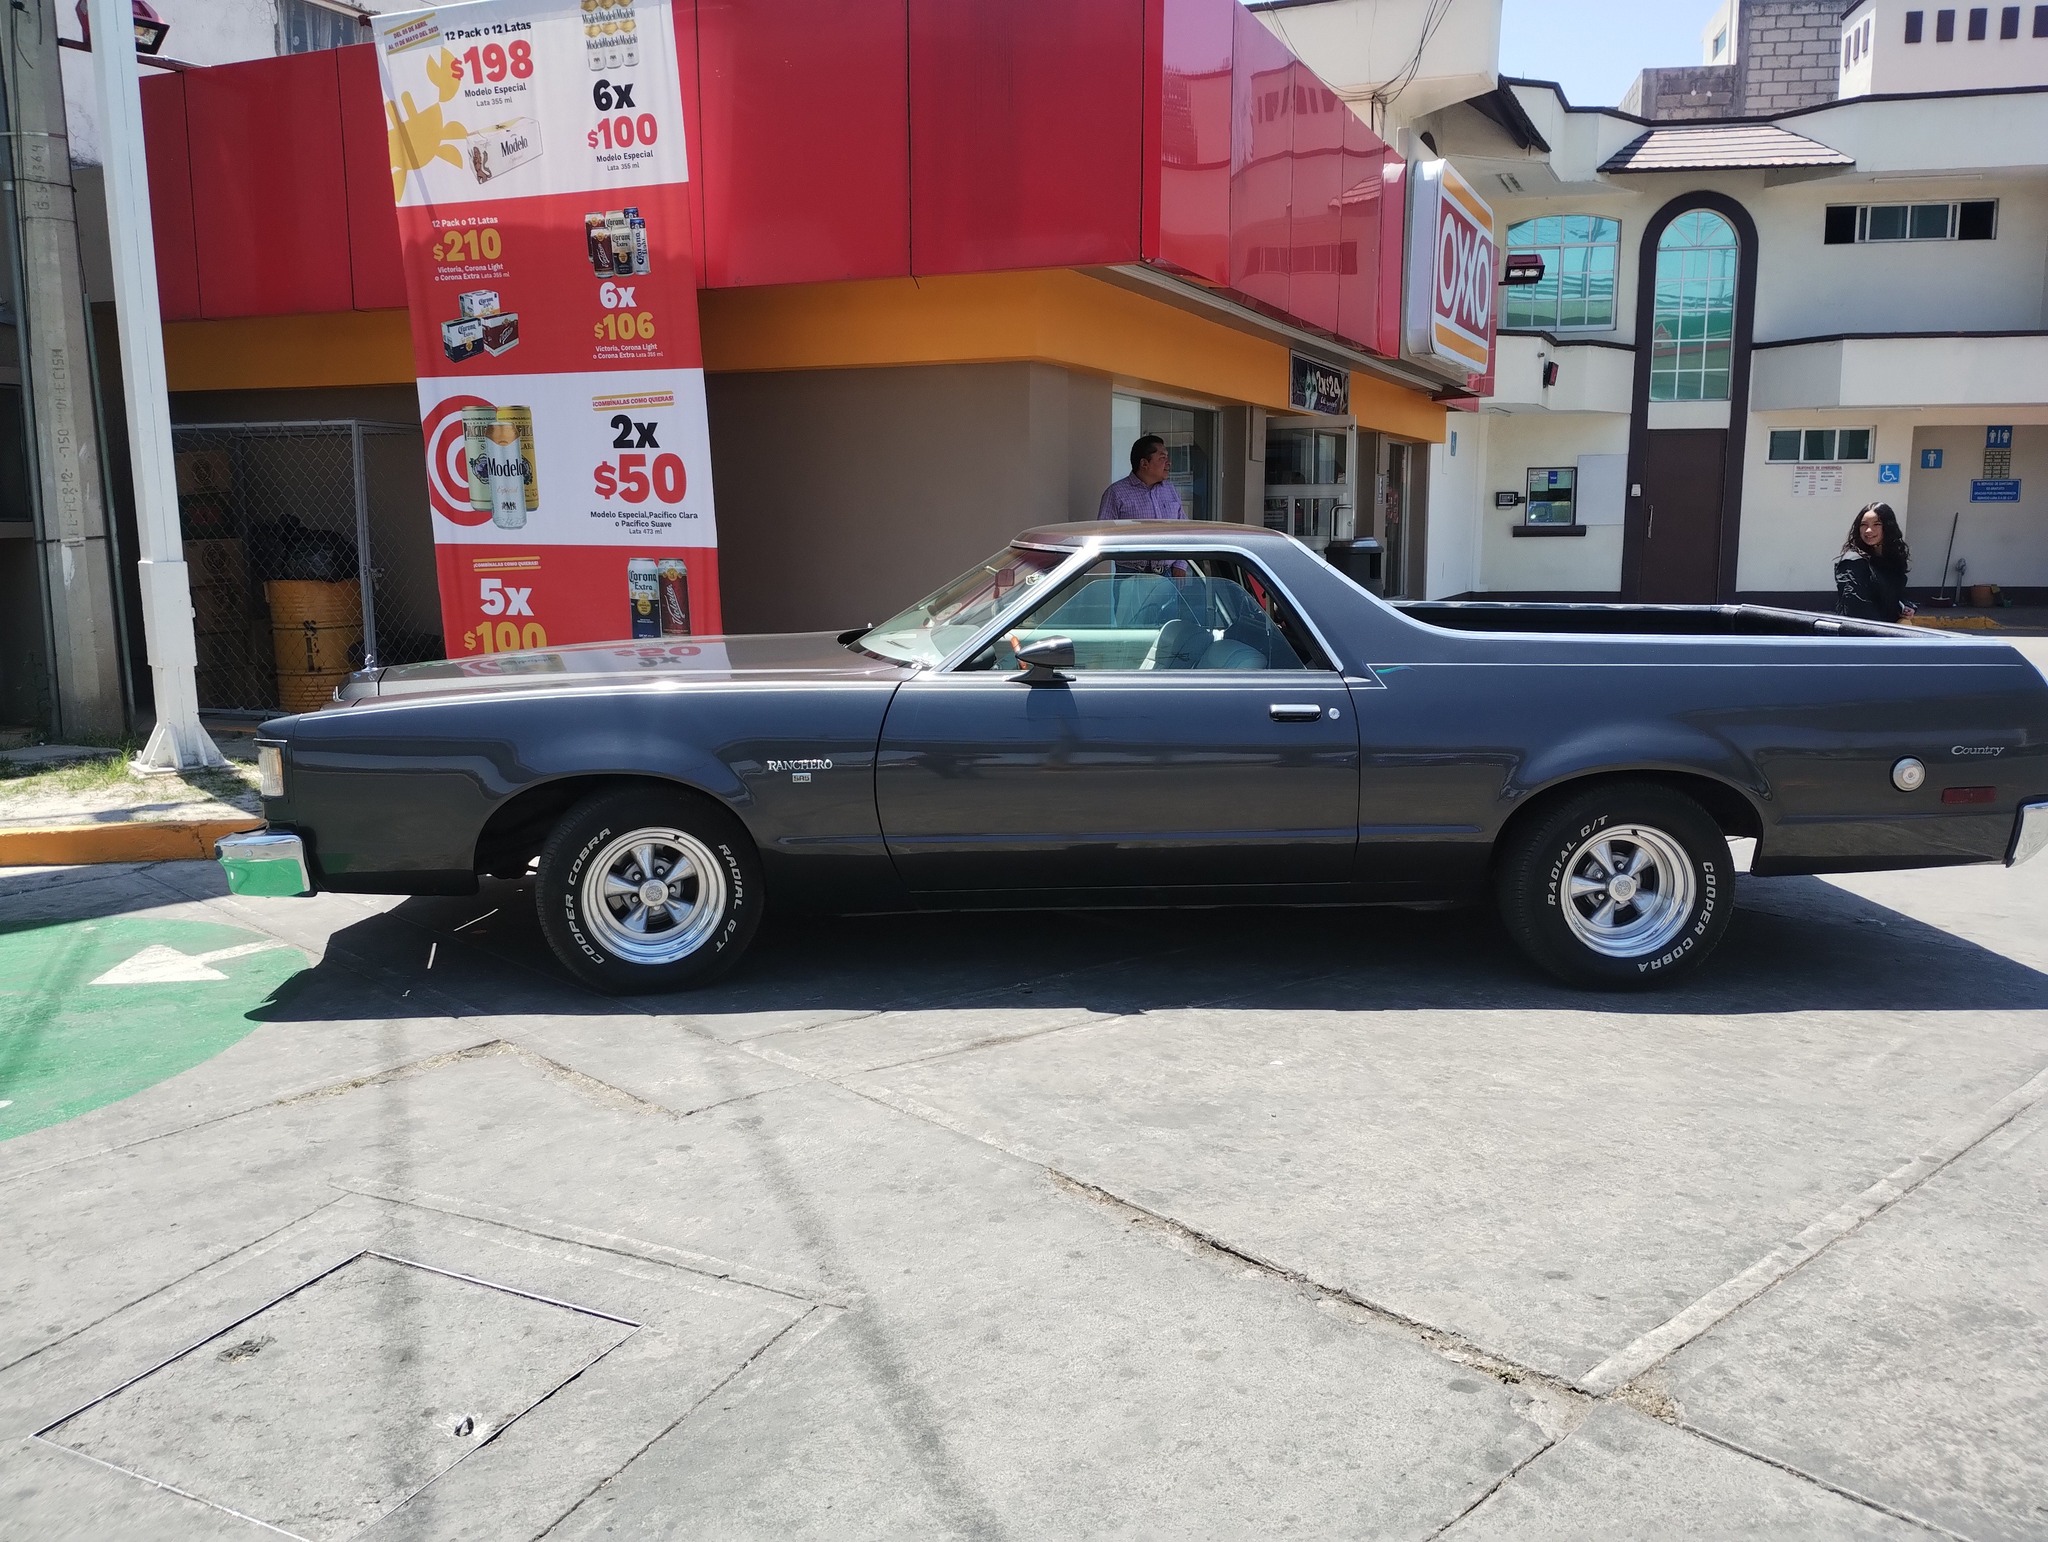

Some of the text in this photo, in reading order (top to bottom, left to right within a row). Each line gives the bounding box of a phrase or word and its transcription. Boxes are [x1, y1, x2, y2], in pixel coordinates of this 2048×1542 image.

[445, 21, 532, 41] 12 Pack o 12 Latas
[450, 39, 534, 84] $198
[464, 82, 527, 98] Modelo Especial
[476, 96, 513, 107] Lata 355 ml
[593, 79, 636, 112] 6x
[587, 112, 658, 150] $100
[500, 136, 529, 157] Modelo
[596, 150, 654, 163] Modelo Especial
[432, 220, 440, 228] 12
[441, 218, 460, 227] Pack
[467, 217, 477, 225] 12
[477, 216, 499, 225] Latas
[432, 228, 502, 262] $210
[437, 265, 464, 273] Victoria,
[487, 263, 504, 272] Light
[1440, 213, 1489, 330] OXXO
[599, 281, 637, 309] 6x
[594, 311, 655, 340] $106
[642, 343, 658, 351] Light
[610, 414, 660, 449] 2x
[487, 457, 524, 477] Modelo
[593, 453, 687, 504] $50
[679, 511, 698, 519] Clara
[628, 570, 658, 583] Corona
[634, 582, 653, 590] Extra
[480, 578, 535, 616] 5x
[463, 621, 548, 654] $100
[1951, 745, 2005, 756] Country
[766, 759, 833, 772] RANCHERO
[1547, 814, 1608, 906] RADIAL G/T
[565, 827, 612, 964] COOPER COBRA
[716, 843, 744, 952] RADIAL G/T
[1637, 861, 1717, 973] COOPER COBRA
